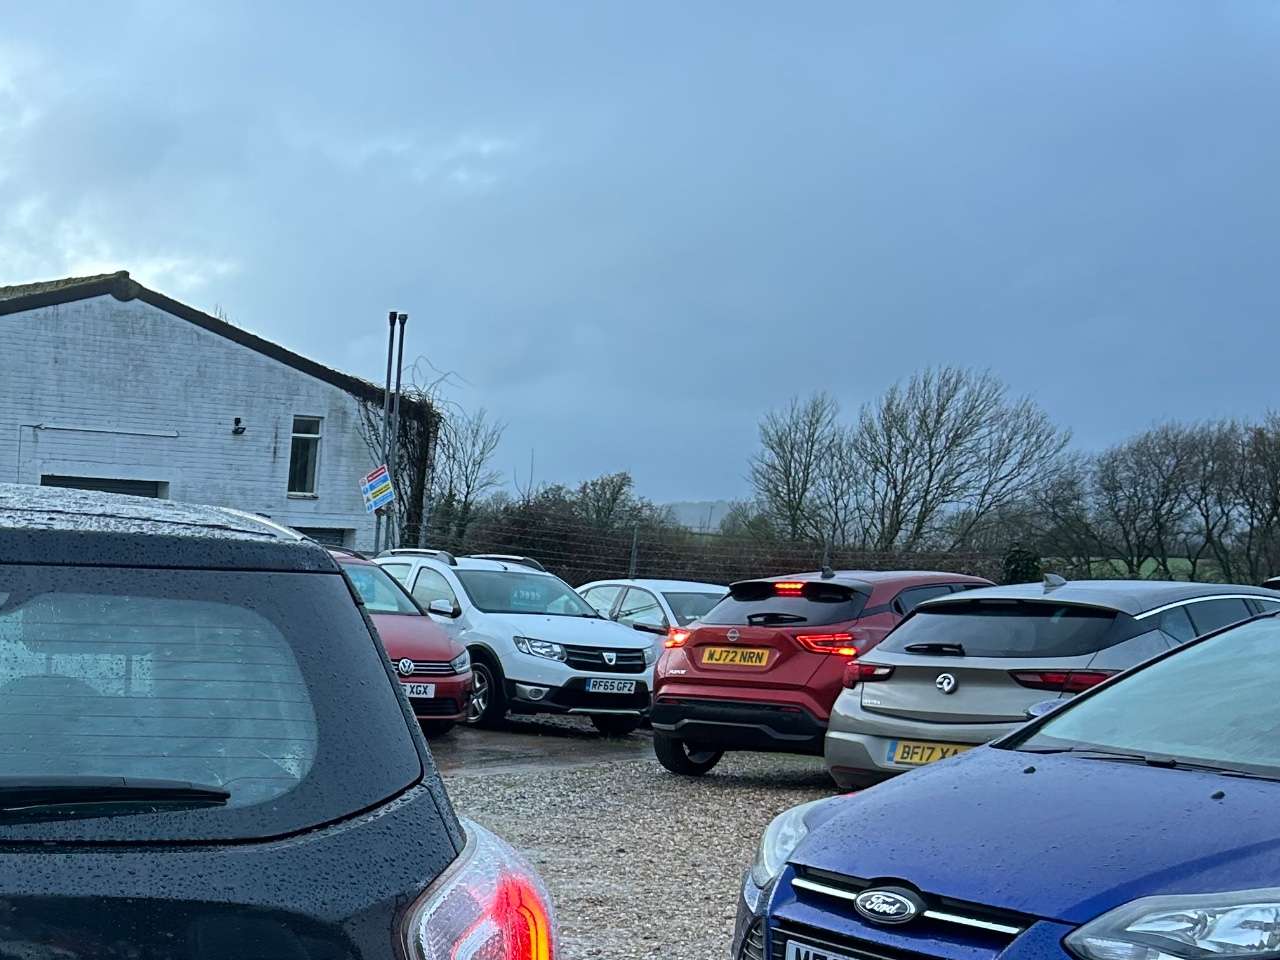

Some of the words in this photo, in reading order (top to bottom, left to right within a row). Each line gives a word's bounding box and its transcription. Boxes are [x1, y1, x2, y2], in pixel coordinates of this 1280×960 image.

[707, 649, 738, 663] WJ72
[739, 651, 765, 664] NRN
[409, 684, 429, 696] XGX
[591, 680, 616, 691] RF65
[616, 681, 634, 692] GFZ
[901, 744, 935, 762] BF17
[865, 894, 901, 915] Ford
